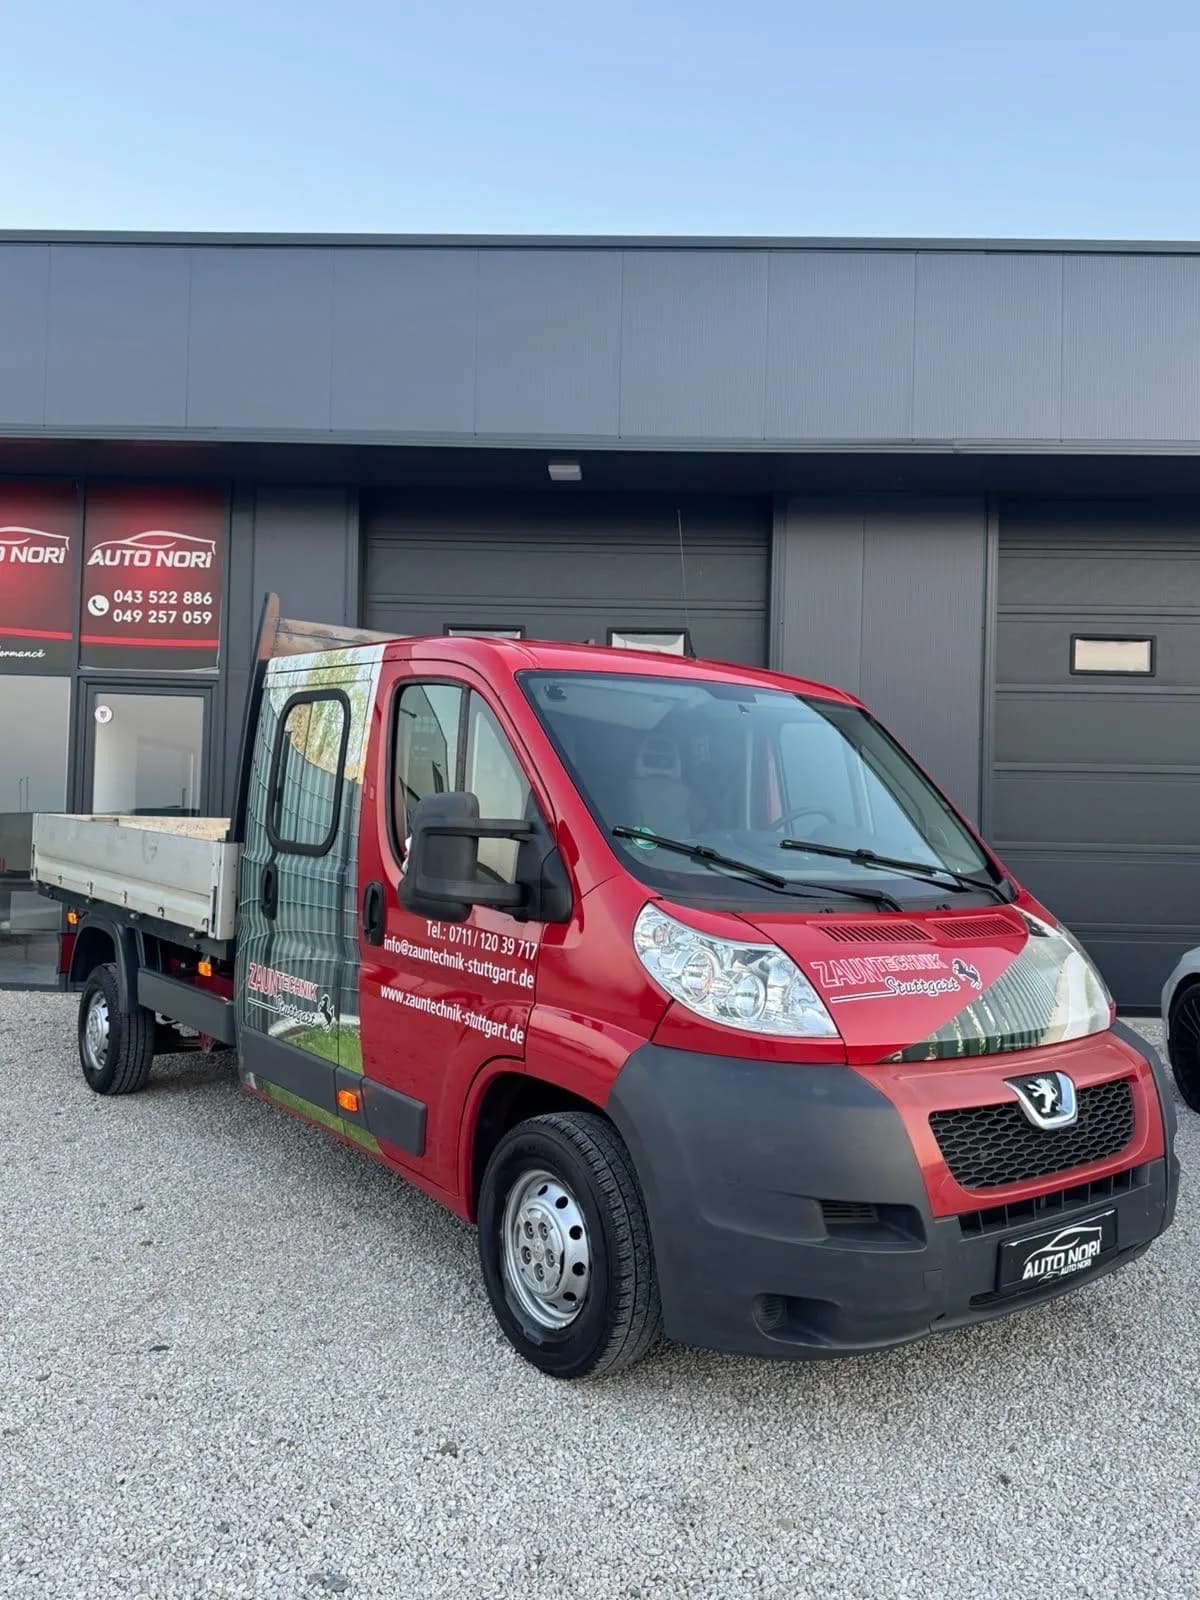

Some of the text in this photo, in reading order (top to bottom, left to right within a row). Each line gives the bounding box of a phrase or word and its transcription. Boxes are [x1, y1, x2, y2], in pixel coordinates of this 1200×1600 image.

[87, 549, 152, 567] AUTO
[113, 589, 213, 605] 043 522 886
[113, 609, 213, 625] 049 257 059
[426, 919, 447, 941] Tel.:
[500, 936, 515, 956] 39
[517, 939, 538, 961] 717
[383, 934, 535, 989] info@zauntechnik-stuttgart.de
[810, 953, 949, 988] ZAUNTECHNIK
[248, 963, 318, 1002] ZAUNTECHNIK
[884, 976, 961, 997] Stuttgart
[276, 994, 315, 1027] Stuttgart
[380, 984, 525, 1045] www.zauntechnik-stuttgart.de
[1022, 1240, 1100, 1280] AUTO NORI
[1060, 1259, 1092, 1275] AUTO NORI
